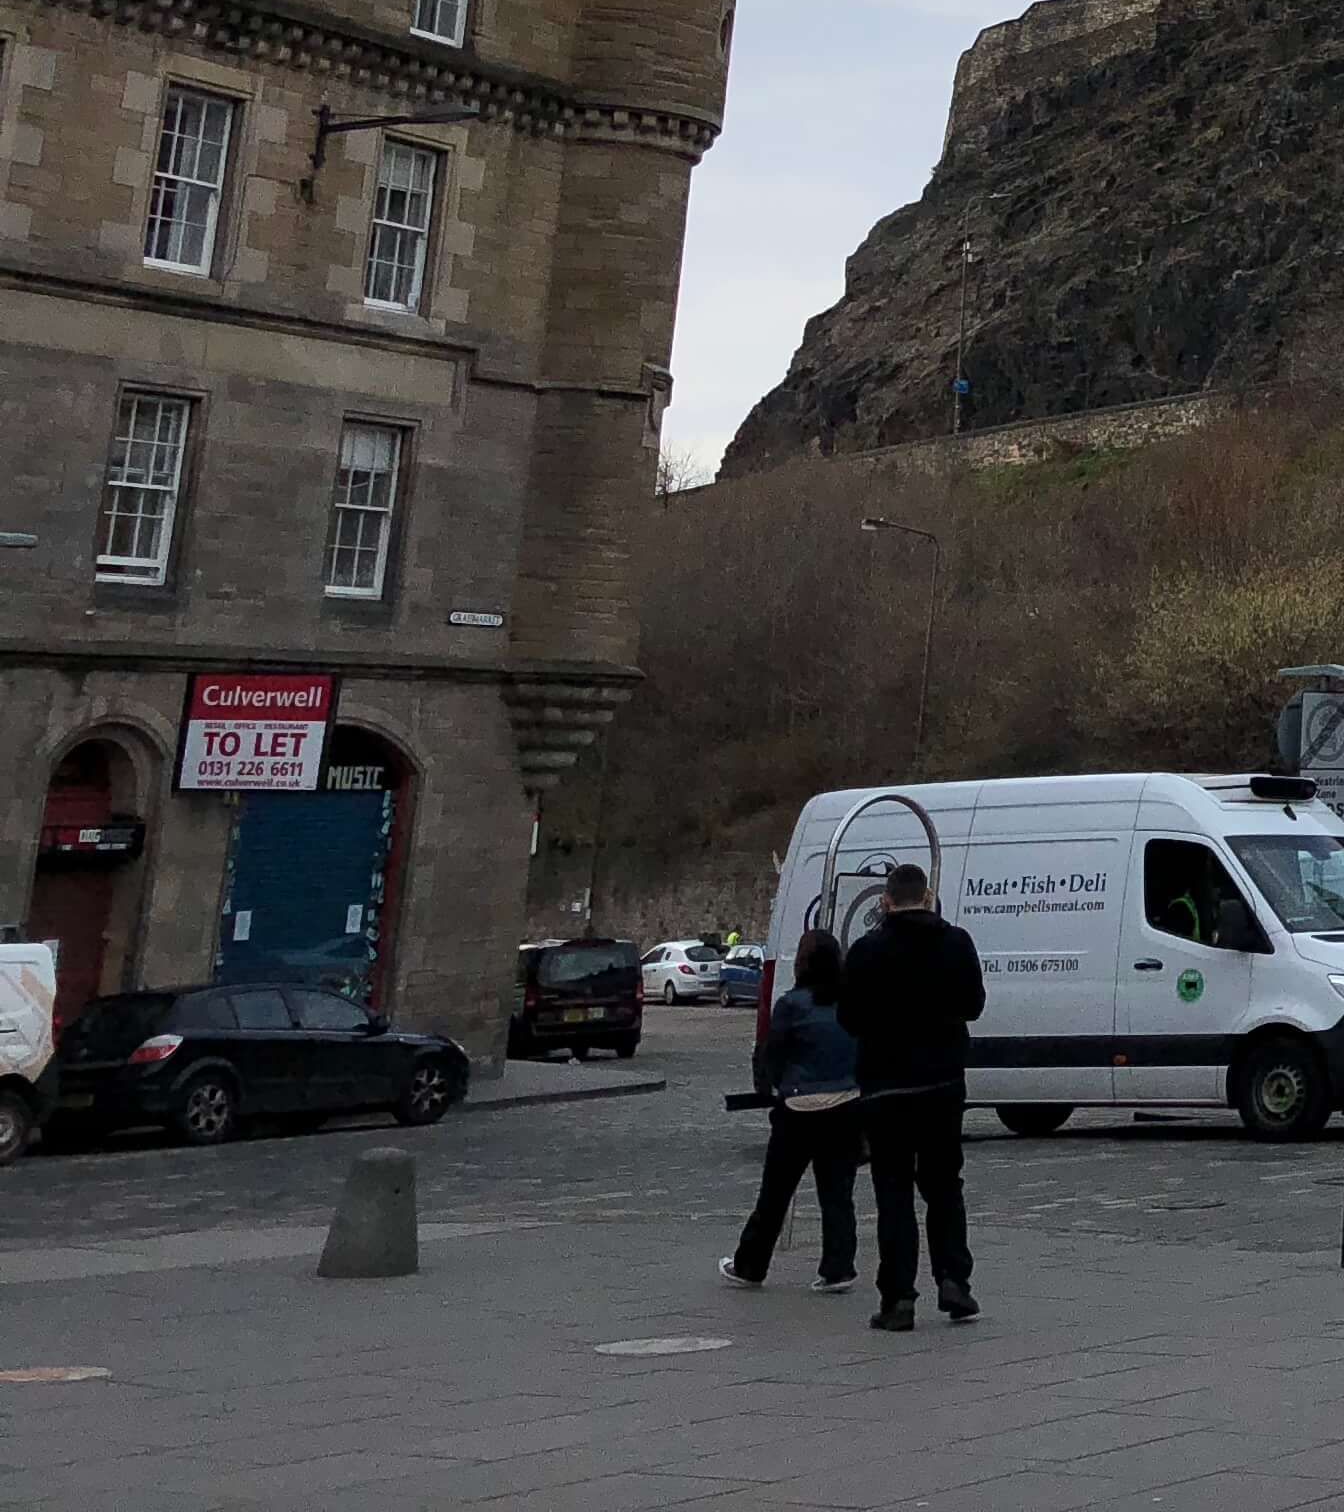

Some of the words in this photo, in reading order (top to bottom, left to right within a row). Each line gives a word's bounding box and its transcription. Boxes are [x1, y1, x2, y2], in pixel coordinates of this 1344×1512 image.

[203, 685, 322, 707] Culverwell
[203, 732, 241, 756] TO
[254, 732, 307, 757] LET
[198, 761, 231, 776] 0131
[237, 761, 264, 776] 226
[271, 761, 303, 776] 6611
[327, 765, 384, 789] MUSIC
[966, 878, 1009, 897] Meat
[1020, 875, 1056, 895] Fish
[1068, 873, 1107, 893] Deli
[963, 899, 1105, 917] www.campbellsmeat.com
[1007, 959, 1039, 973] 01506
[1041, 958, 1079, 972] 675100
